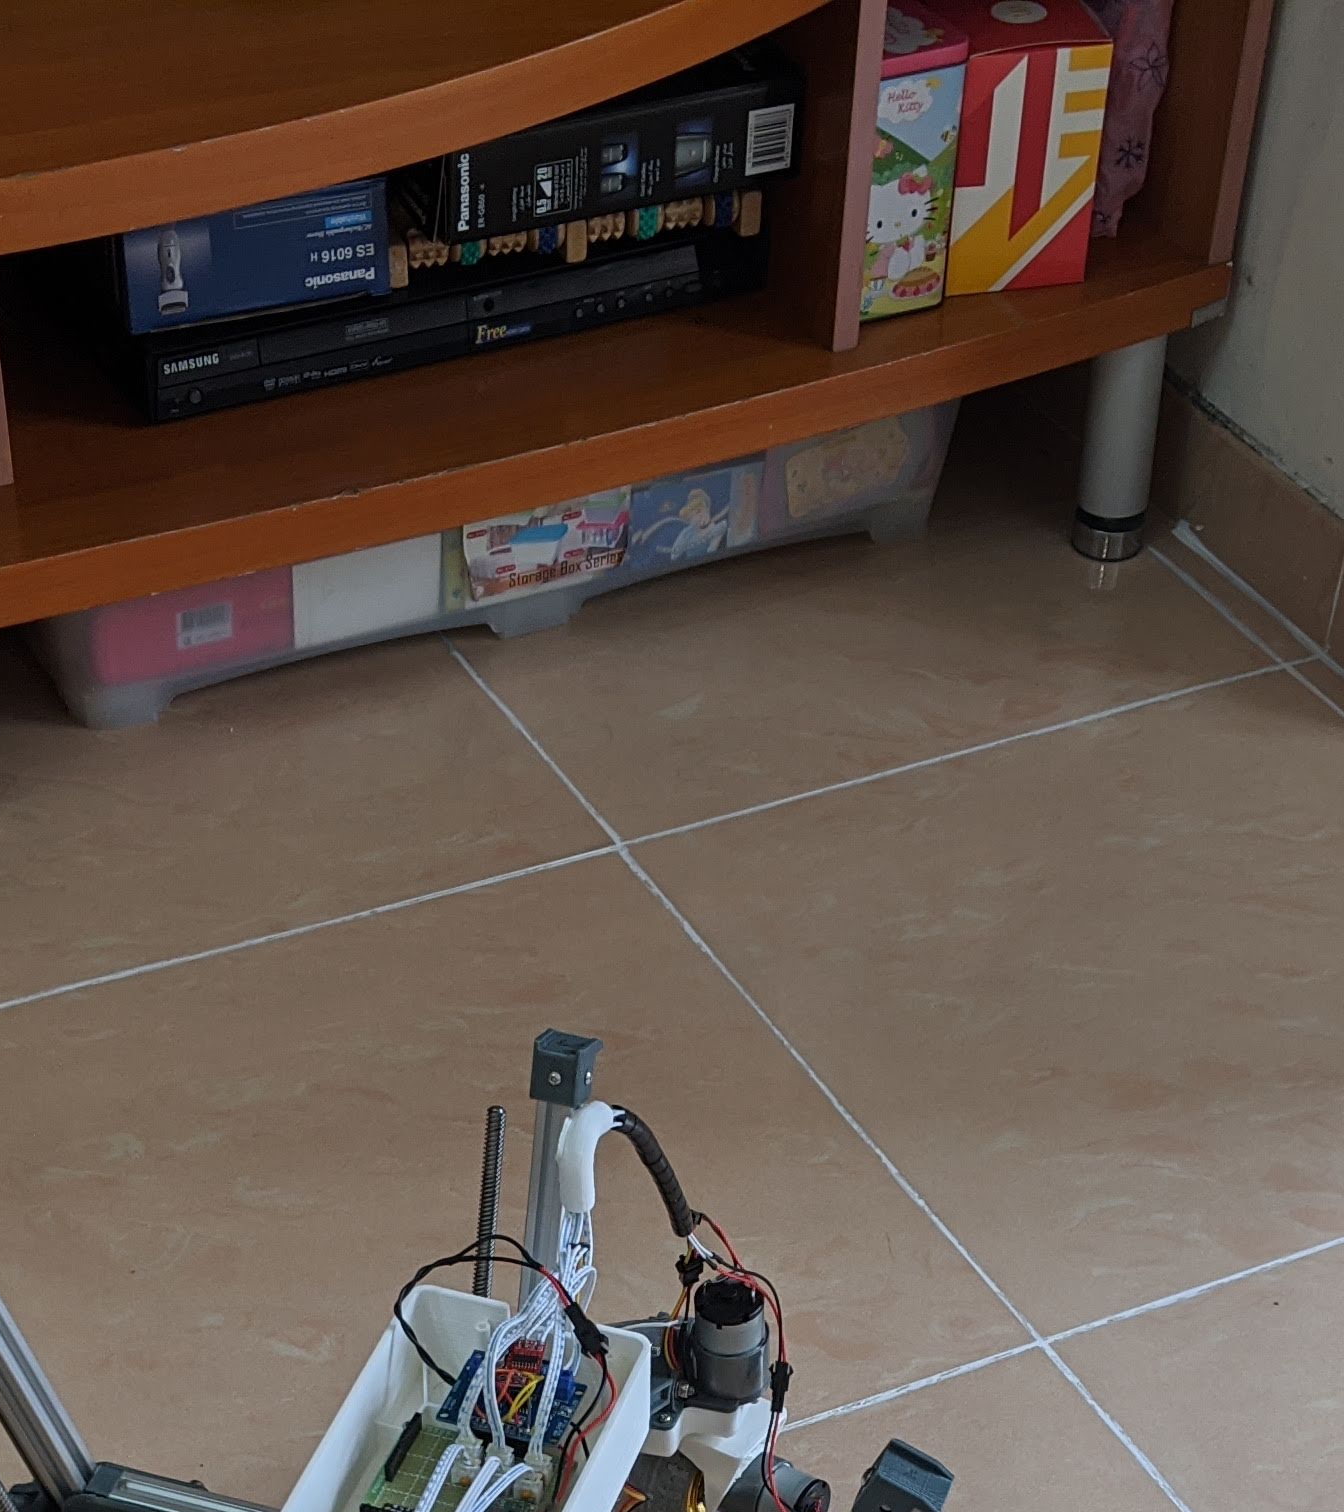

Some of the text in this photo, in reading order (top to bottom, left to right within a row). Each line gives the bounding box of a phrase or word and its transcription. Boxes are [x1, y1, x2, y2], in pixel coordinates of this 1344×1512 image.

[887, 89, 917, 102] Hello
[898, 101, 924, 113] Kitty
[457, 152, 470, 232] Panasonic
[310, 243, 374, 263] ES 6016 H
[304, 267, 375, 289] Panasonic
[475, 323, 508, 345] Free
[163, 352, 220, 376] SAMSUNG
[508, 566, 557, 588] Storage
[560, 559, 583, 577] Box
[585, 548, 625, 571] Series
